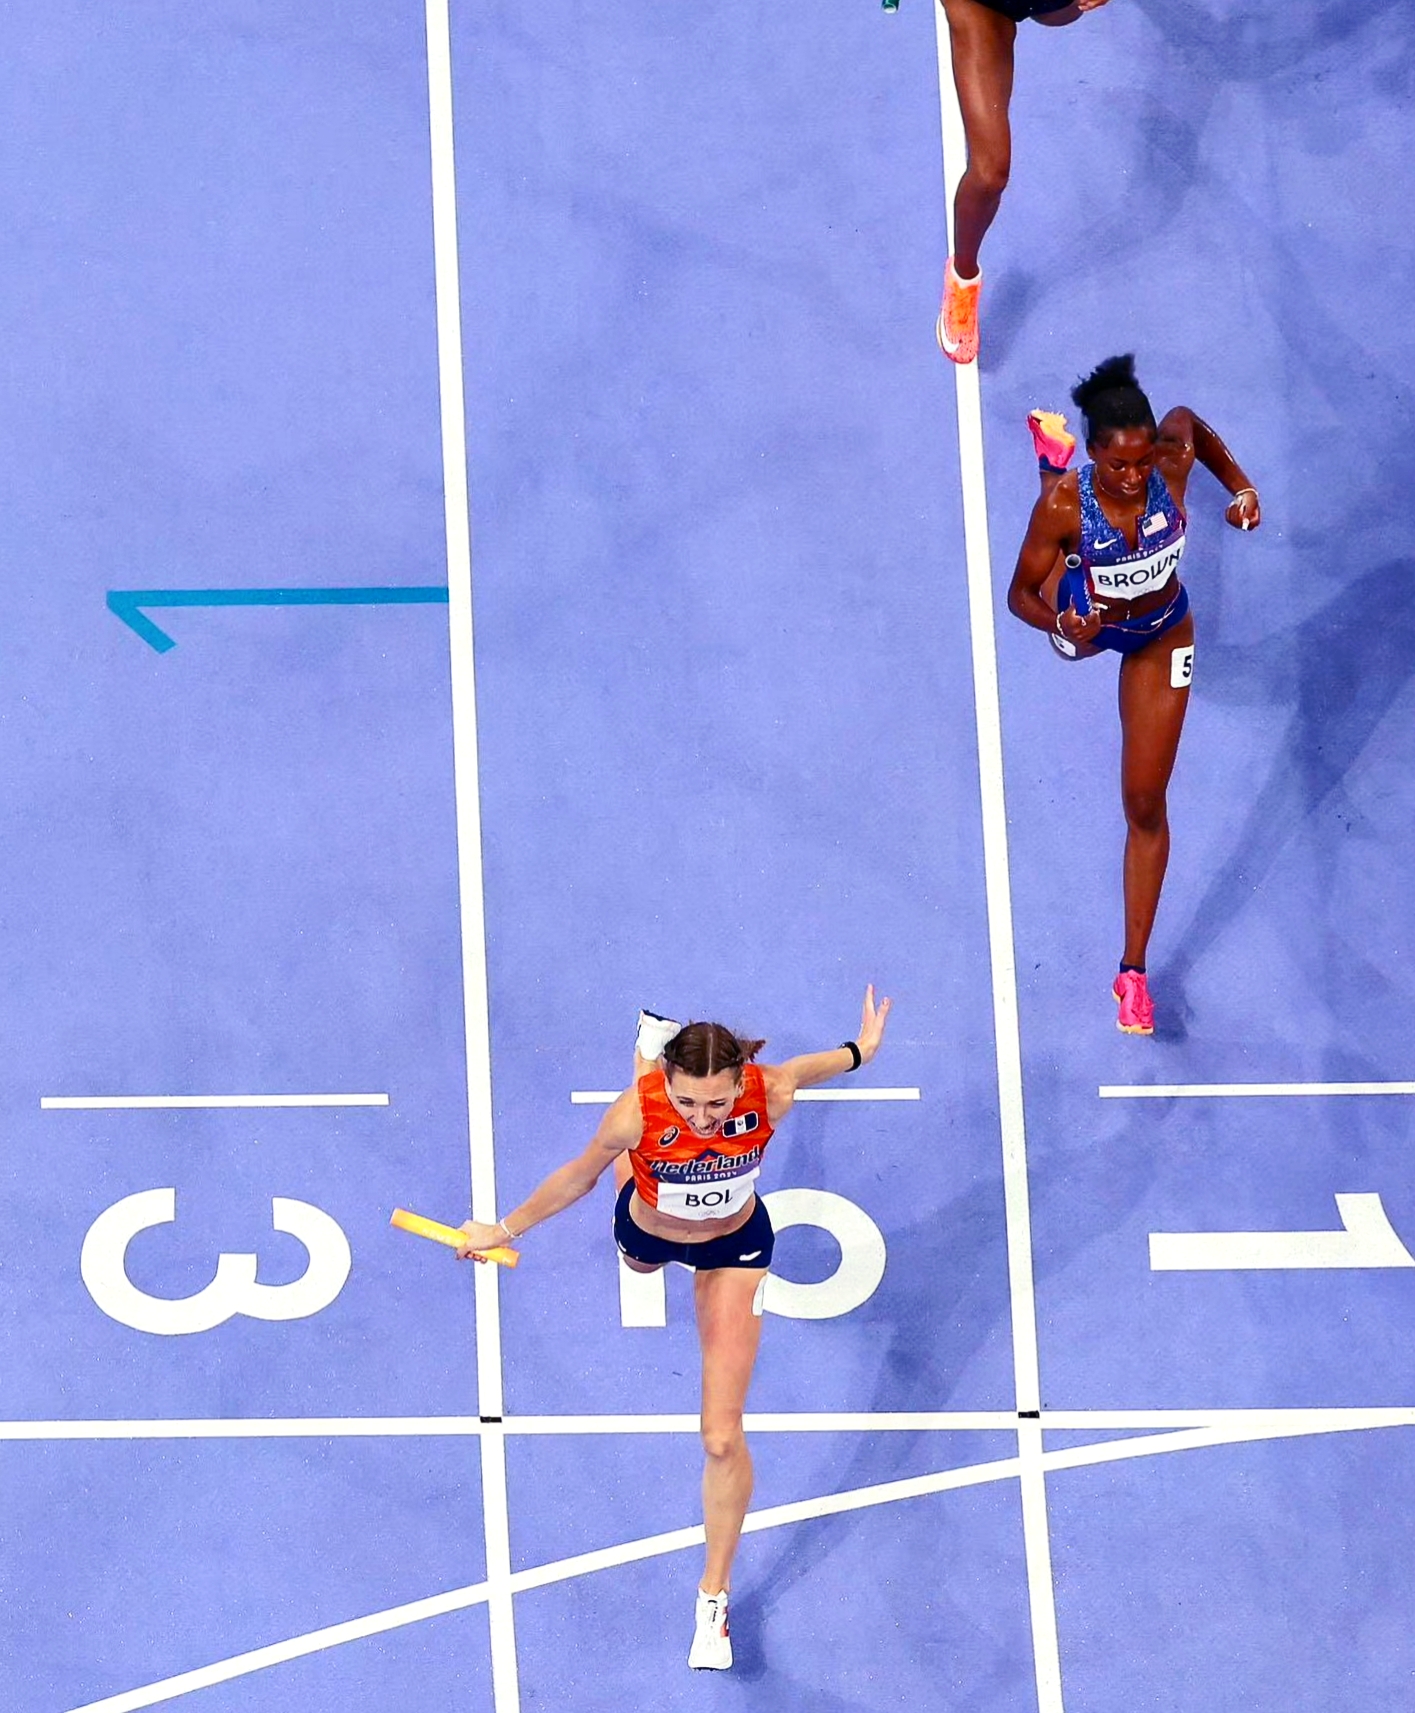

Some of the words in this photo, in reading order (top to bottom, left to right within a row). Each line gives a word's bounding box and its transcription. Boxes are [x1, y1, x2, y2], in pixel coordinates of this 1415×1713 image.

[1097, 547, 1181, 588] BROWN
[1182, 654, 1192, 678] 5
[685, 1173, 711, 1182] PARIS
[685, 1188, 734, 1208] BOL
[1148, 1192, 1415, 1271] 1
[80, 1187, 352, 1335] 3
